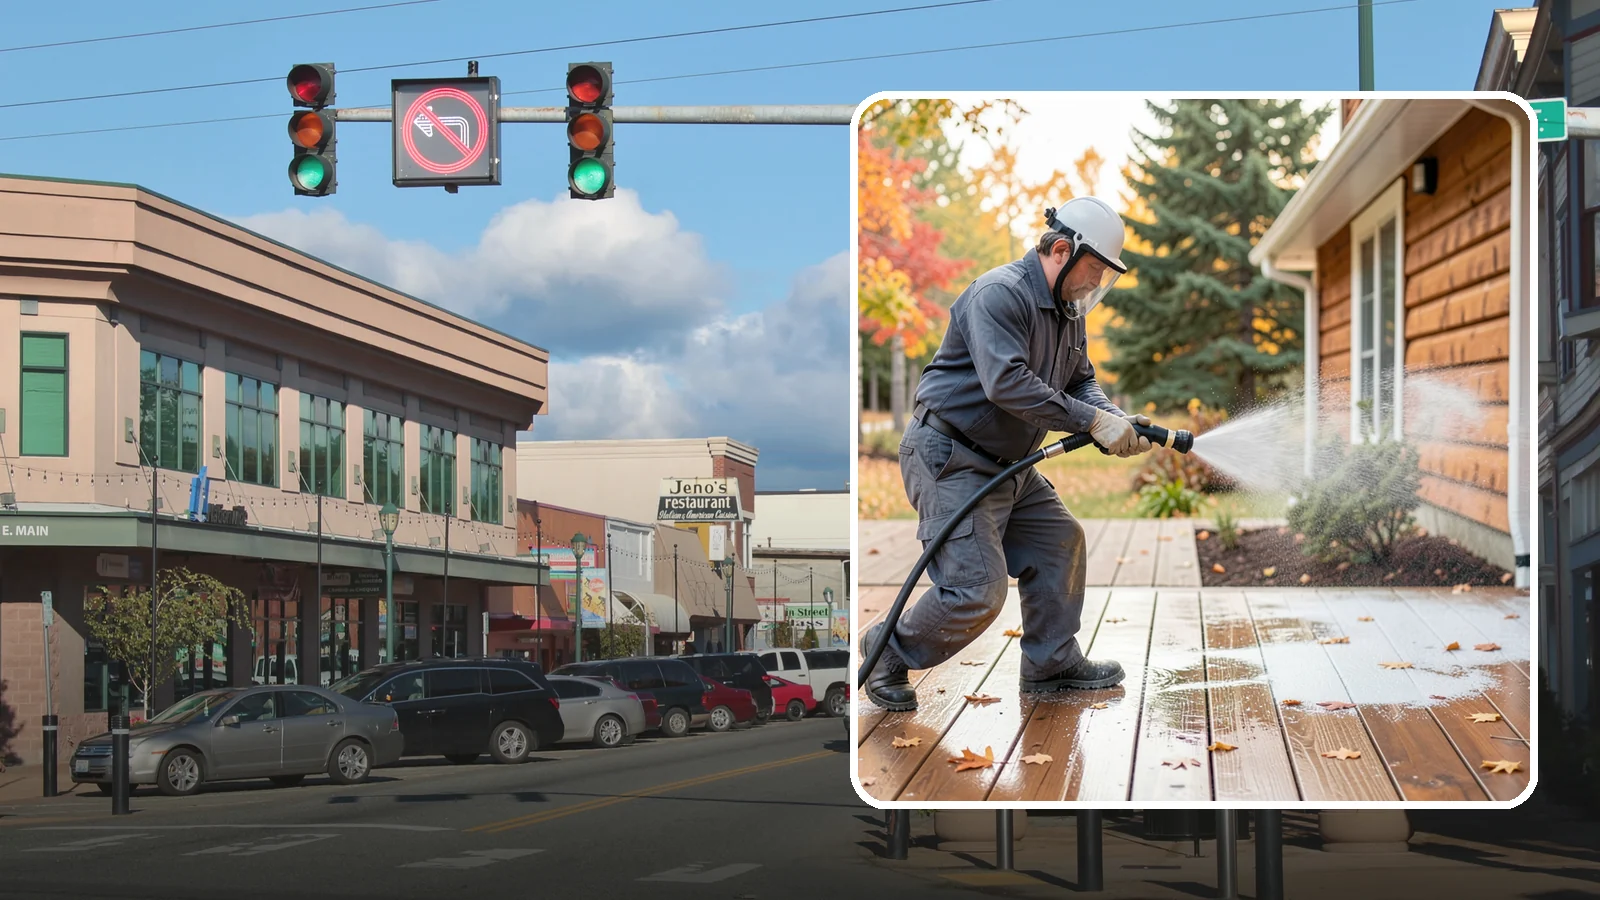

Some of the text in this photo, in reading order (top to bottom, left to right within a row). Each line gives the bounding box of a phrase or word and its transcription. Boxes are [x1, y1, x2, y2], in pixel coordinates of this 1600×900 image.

[669, 480, 728, 494] Jeno's
[665, 496, 731, 509] restaurant
[686, 509, 715, 519] American
[715, 509, 738, 520] Cuisine
[2, 525, 49, 536] E. MAIN
[797, 608, 828, 616] Street
